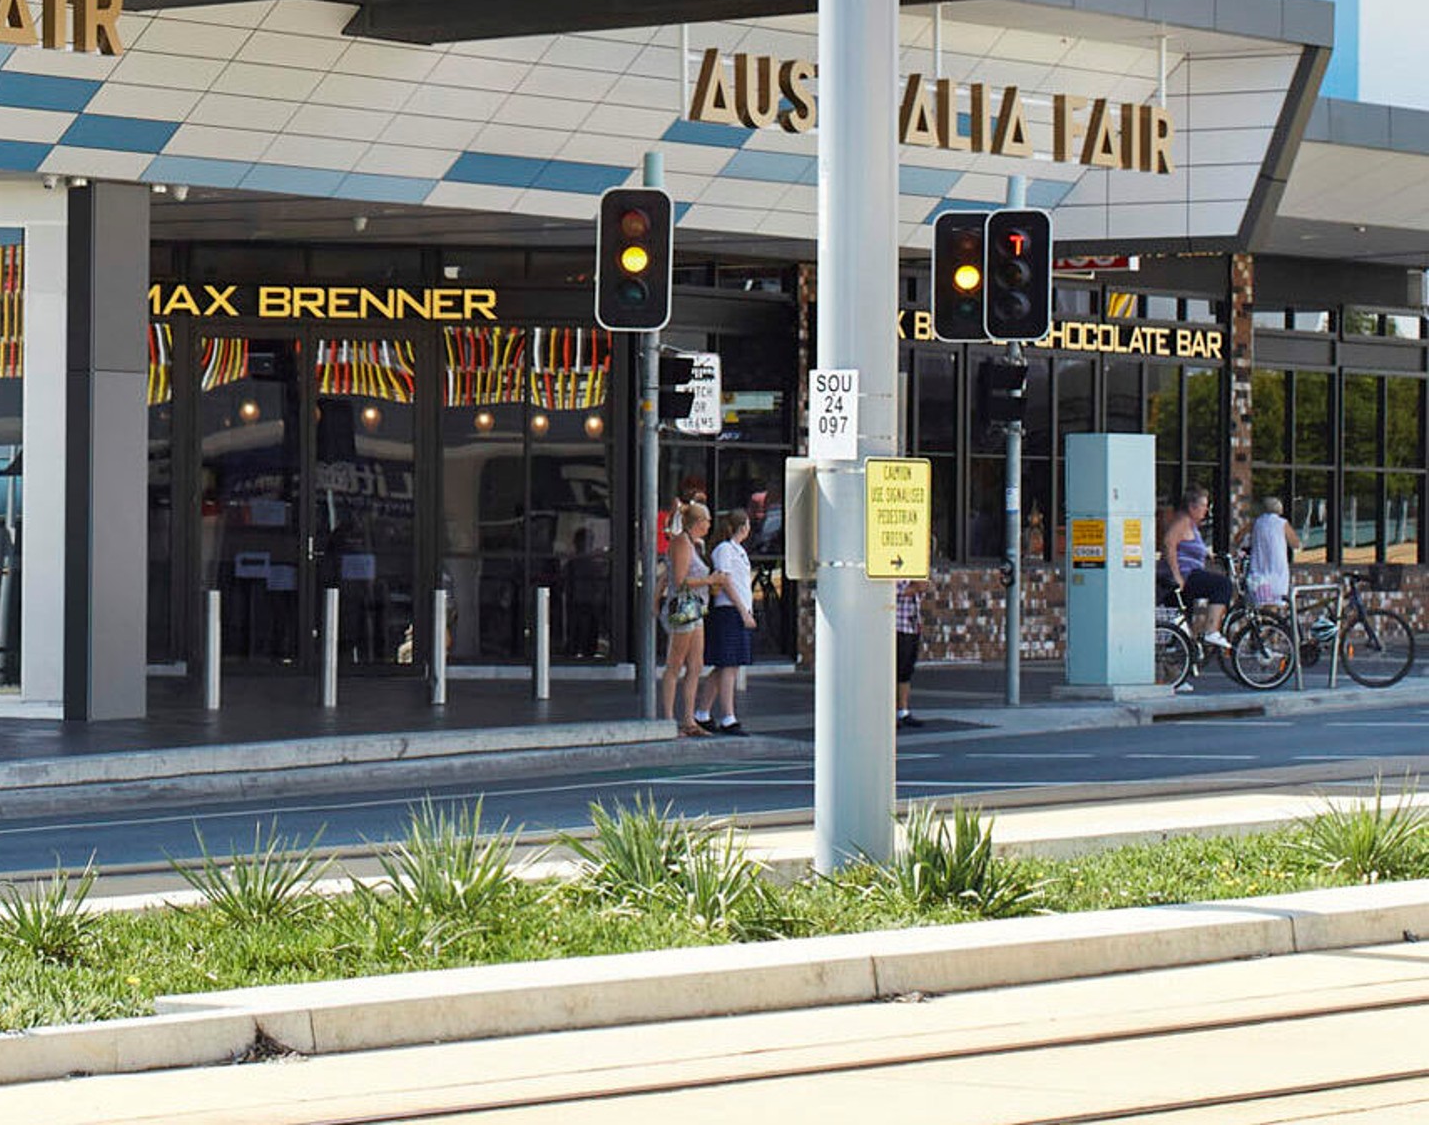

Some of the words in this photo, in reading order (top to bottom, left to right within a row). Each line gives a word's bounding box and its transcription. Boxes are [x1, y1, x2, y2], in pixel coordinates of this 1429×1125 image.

[689, 47, 1033, 158] AUSALIA
[1053, 94, 1174, 174] FAIR
[258, 286, 497, 320] BRENNER
[1176, 324, 1222, 360] BAR
[816, 374, 852, 393] SOU
[824, 395, 844, 413] 24
[818, 416, 848, 434] 097
[877, 508, 917, 524] PEDESTRIAN
